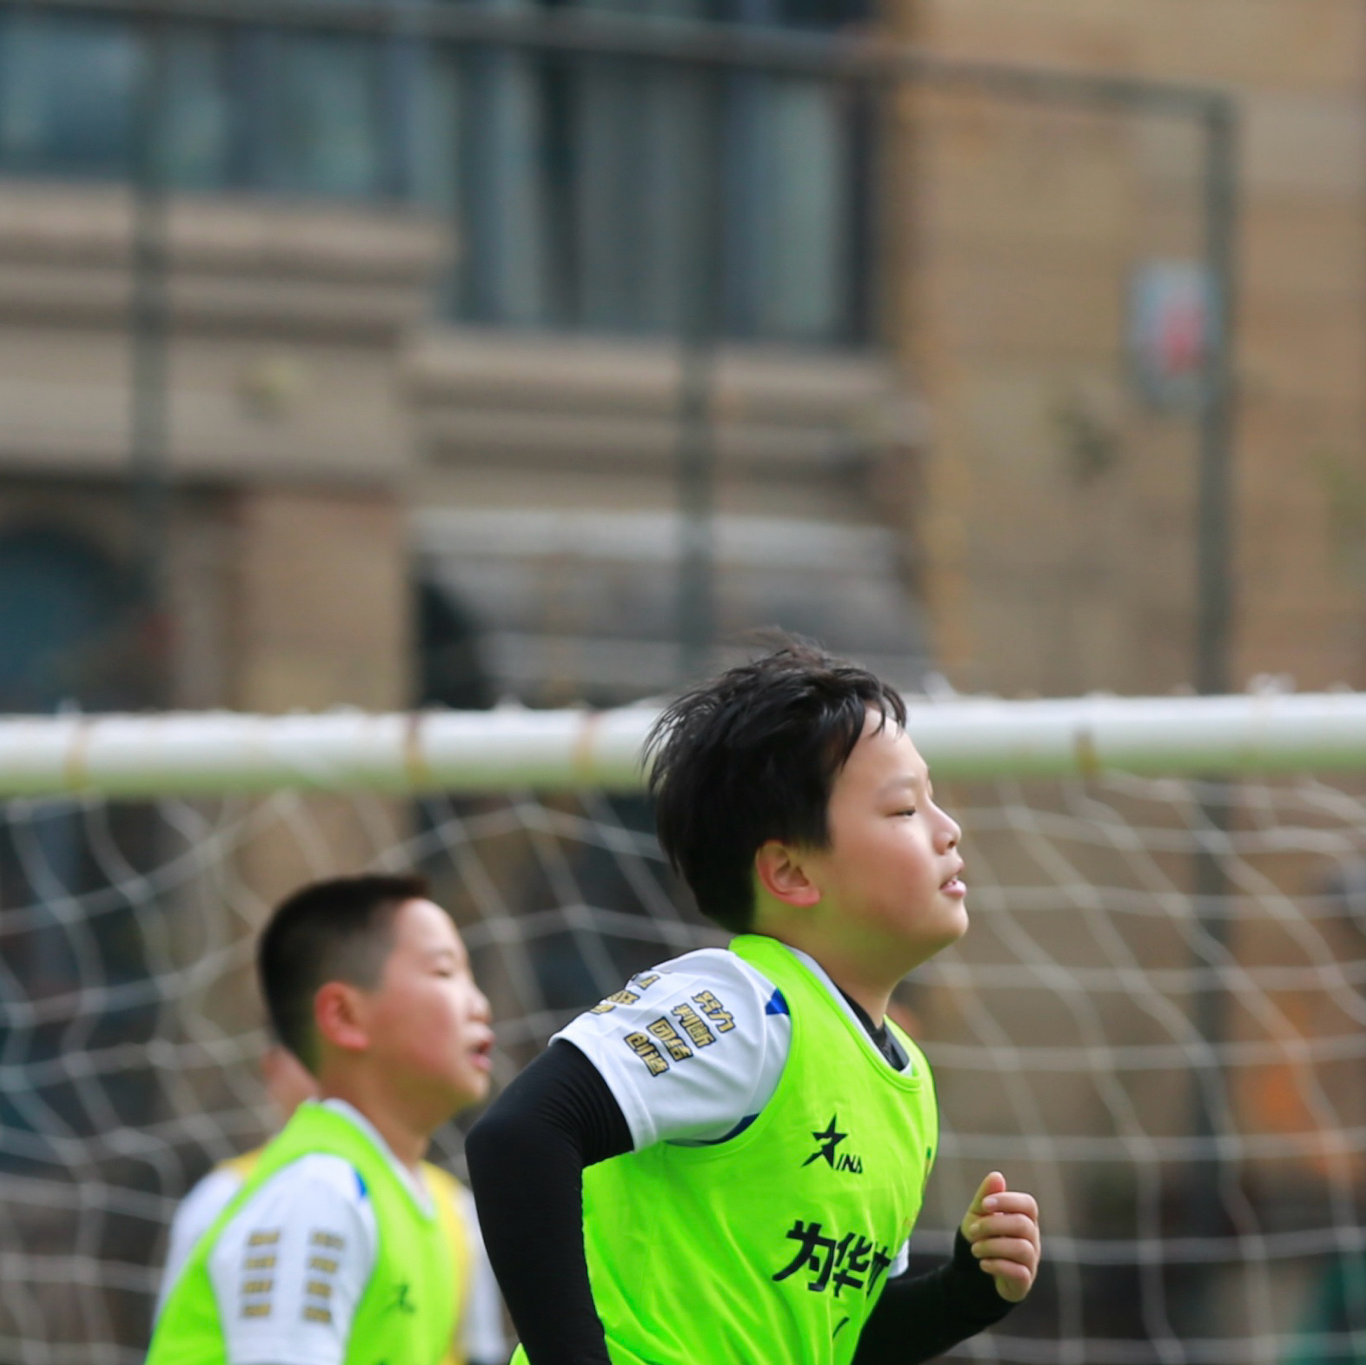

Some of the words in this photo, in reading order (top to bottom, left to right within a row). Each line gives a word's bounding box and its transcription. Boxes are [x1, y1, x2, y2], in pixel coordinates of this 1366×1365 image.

[691, 990, 736, 1034] 努力
[623, 1032, 670, 1077] 创造
[646, 1015, 693, 1062] 团结
